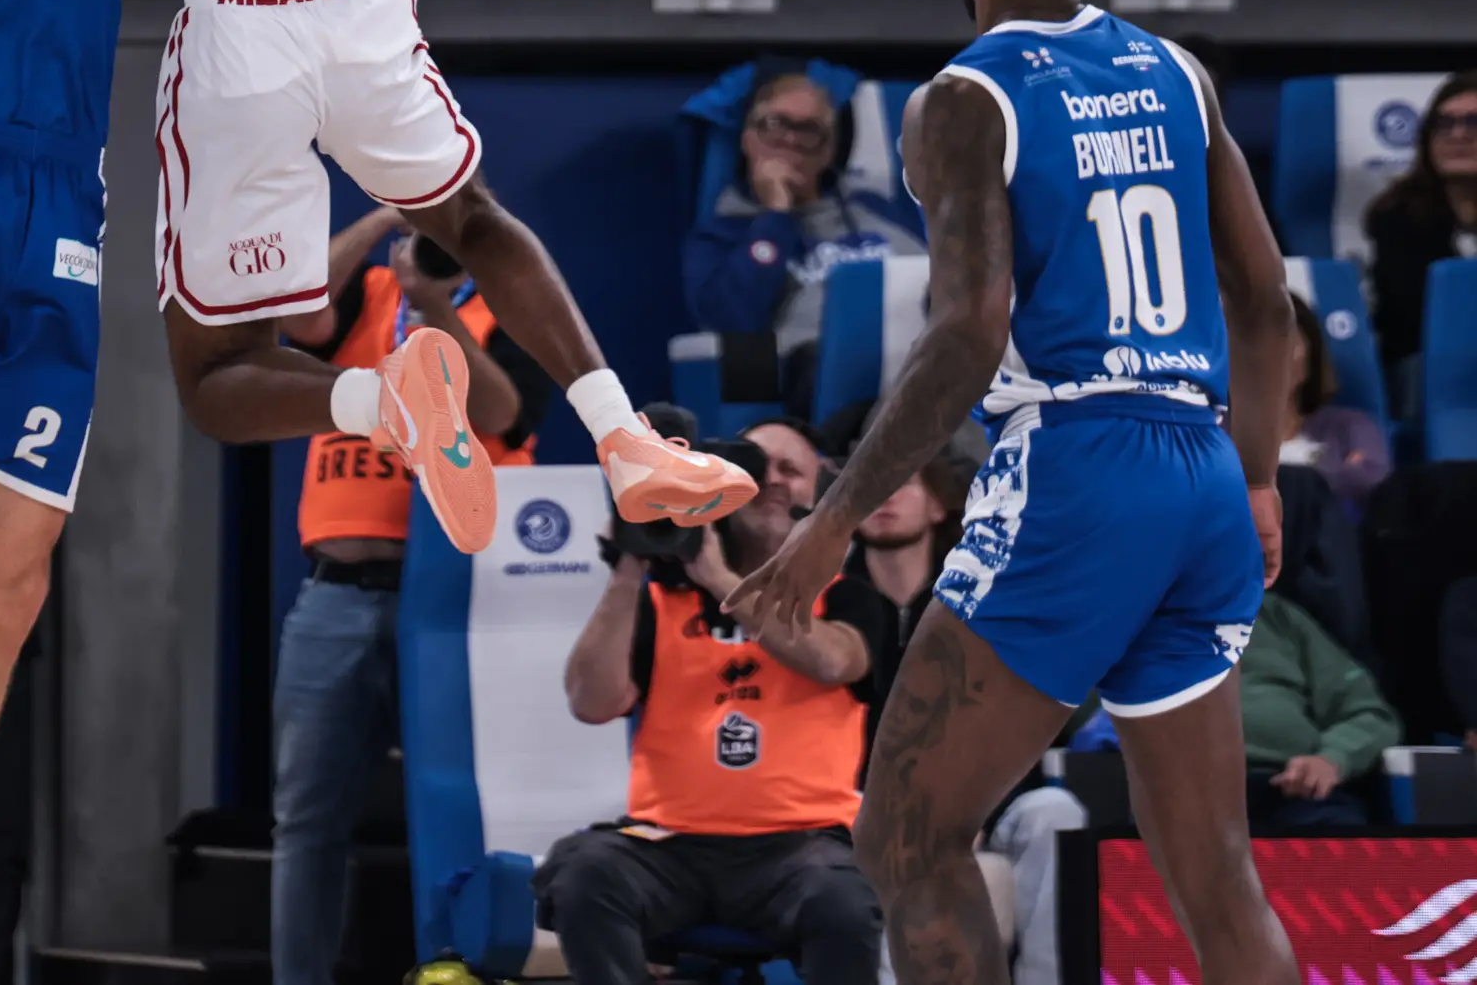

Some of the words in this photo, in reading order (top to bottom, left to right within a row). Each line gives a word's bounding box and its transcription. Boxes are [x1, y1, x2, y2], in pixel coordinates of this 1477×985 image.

[1061, 87, 1166, 122] bonera.
[1072, 125, 1174, 180] BURNELL
[227, 234, 268, 253] ACQUA
[269, 231, 282, 243] DI
[229, 244, 286, 277] GIÒ
[1086, 183, 1188, 337] 10
[13, 405, 62, 469] 2
